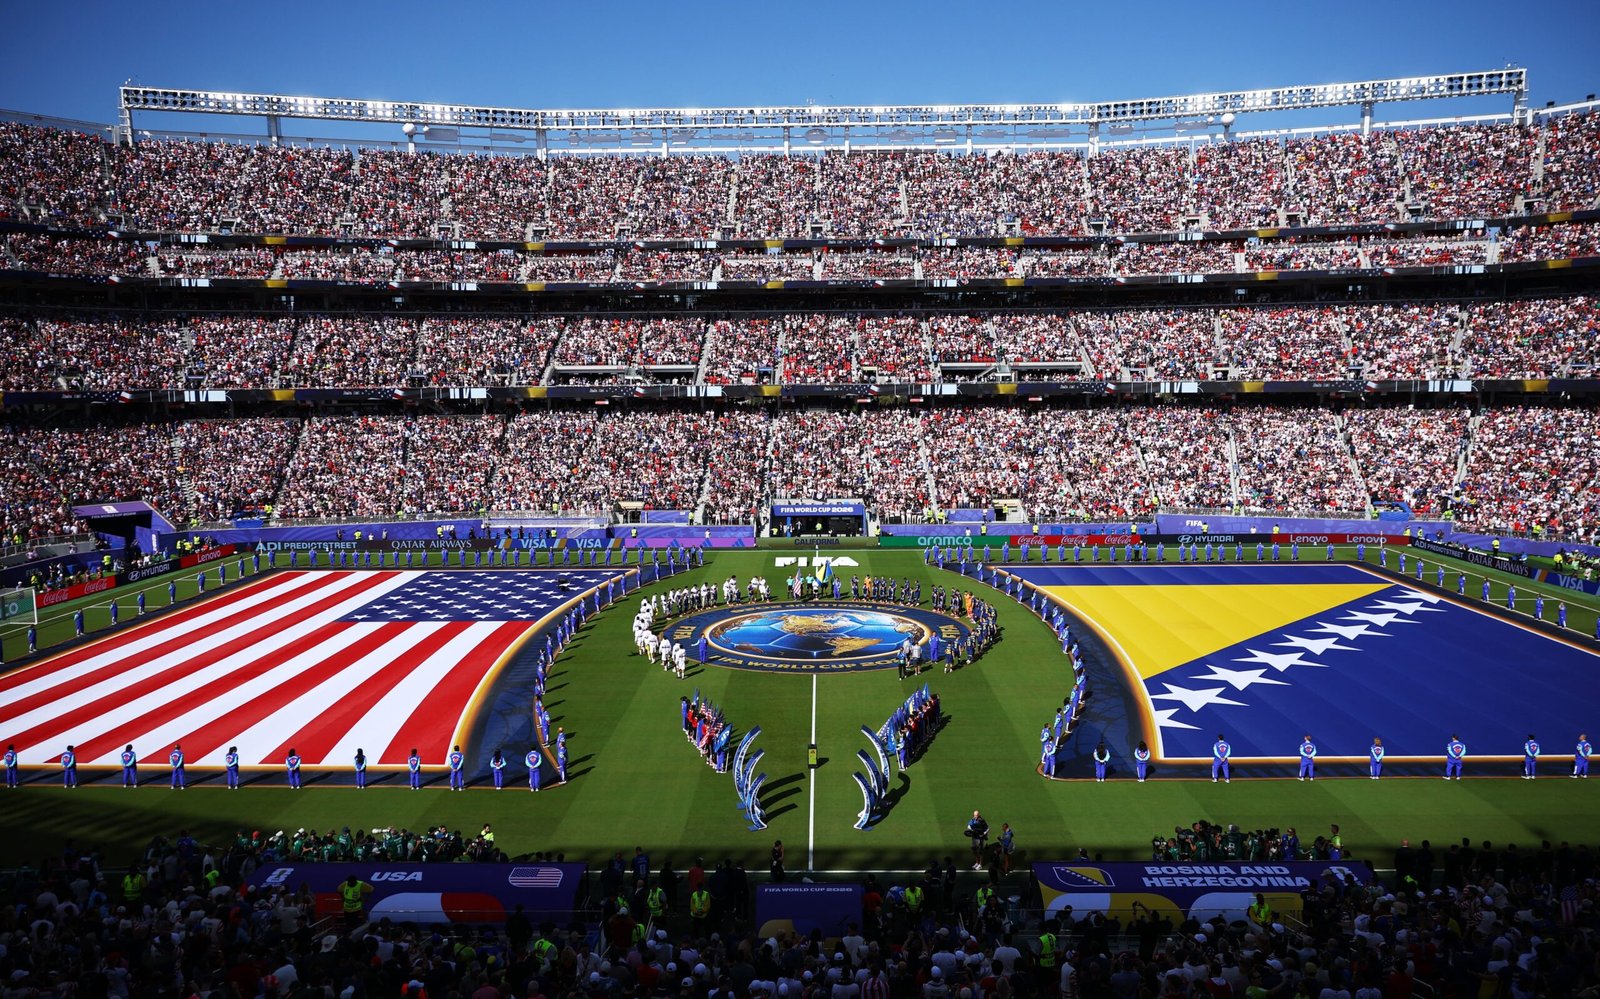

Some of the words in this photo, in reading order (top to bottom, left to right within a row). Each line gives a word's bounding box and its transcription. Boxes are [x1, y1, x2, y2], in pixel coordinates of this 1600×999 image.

[1186, 519, 1203, 527] FIFA
[521, 538, 547, 548] VISA
[575, 538, 602, 548] VISA
[918, 536, 972, 546] aramco
[1290, 534, 1328, 543] Lenovo
[1346, 534, 1387, 544] Lenovo
[256, 542, 281, 551] ADI
[391, 540, 425, 549] QATAR
[430, 540, 472, 549] AIRWAYS
[1427, 543, 1463, 558] PREDICTSTREET
[197, 550, 221, 563] Lenovo
[141, 563, 170, 577] HYUNDAI
[1468, 553, 1493, 567] QATAR
[1495, 560, 1529, 577] AIRWAYS
[1557, 574, 1584, 592] VISA
[747, 661, 815, 669] WORLD
[1144, 865, 1237, 875] BOSNIA
[1240, 865, 1290, 875] AND
[370, 871, 423, 882] USA
[1142, 876, 1312, 887] HERZEGOVINA
